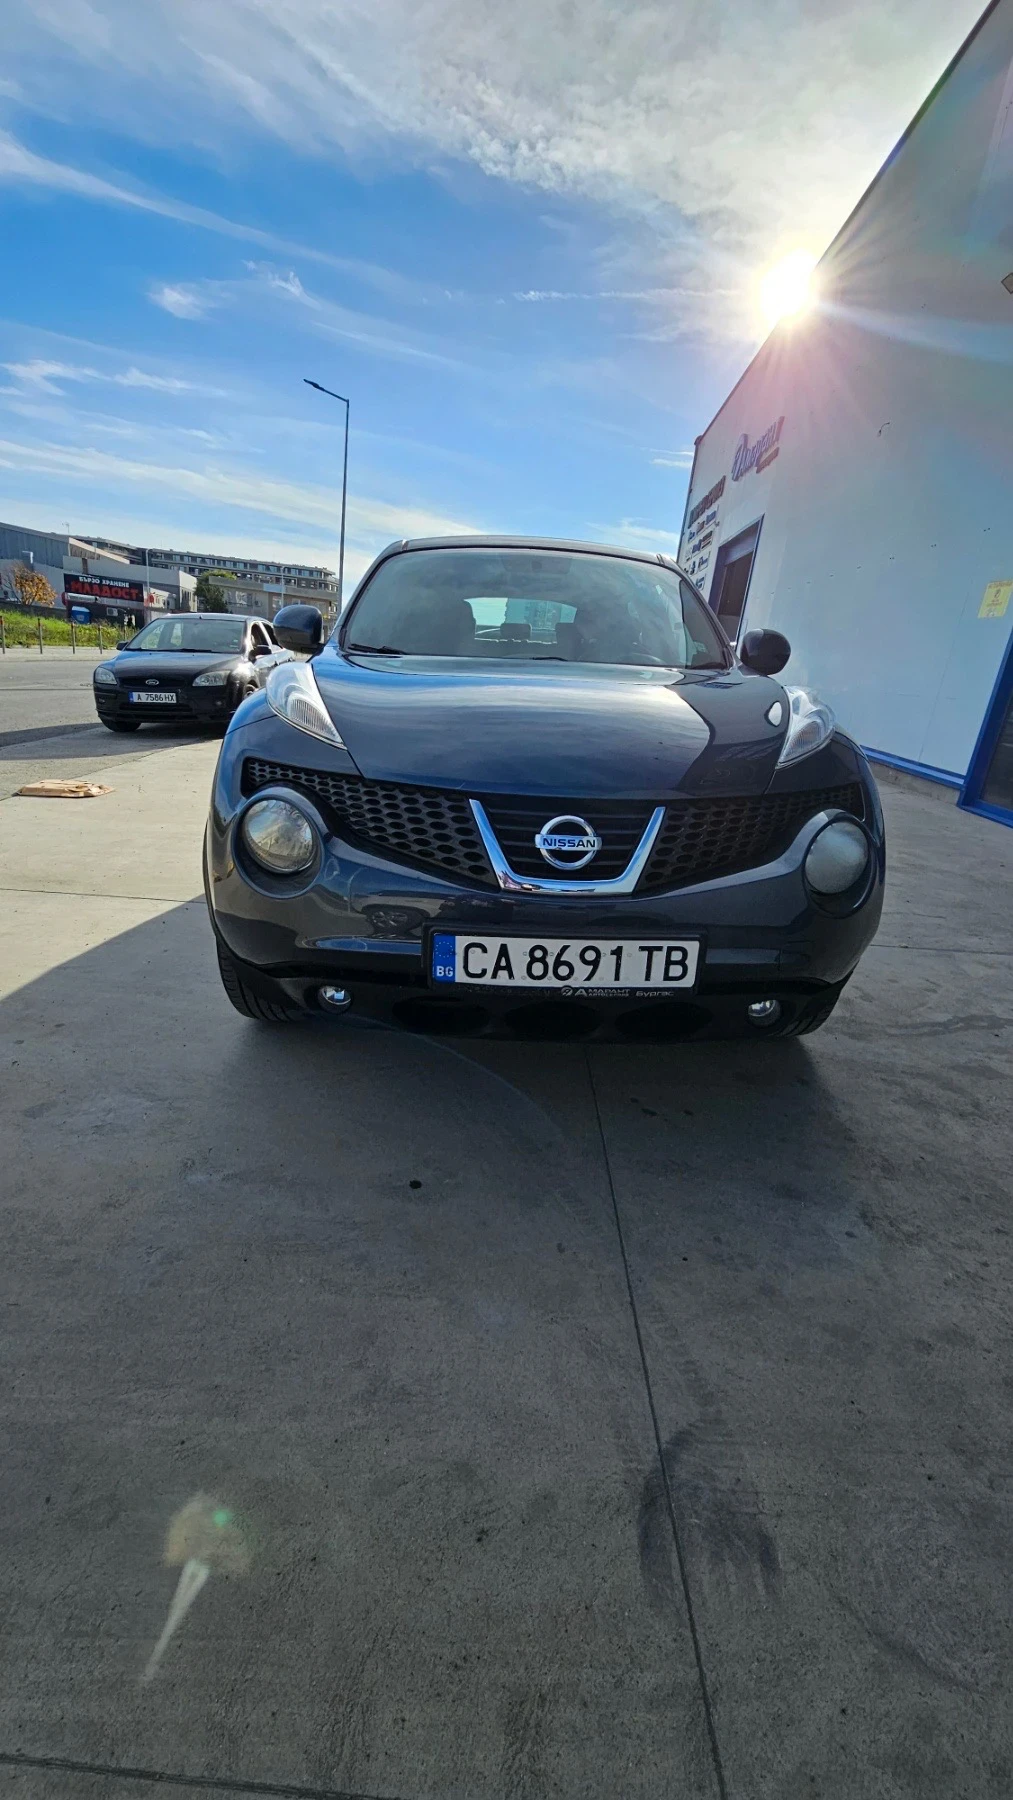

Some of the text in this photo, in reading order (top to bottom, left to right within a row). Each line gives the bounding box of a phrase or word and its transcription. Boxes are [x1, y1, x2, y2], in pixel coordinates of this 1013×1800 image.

[79, 576, 130, 588] БЪРЗО ХРАНЕНЕ
[71, 580, 139, 600] МЛАДОСТ
[145, 693, 164, 702] 7586
[542, 837, 596, 848] NISSAN
[463, 942, 689, 982] CA 8691 TB
[436, 966, 454, 977] BG
